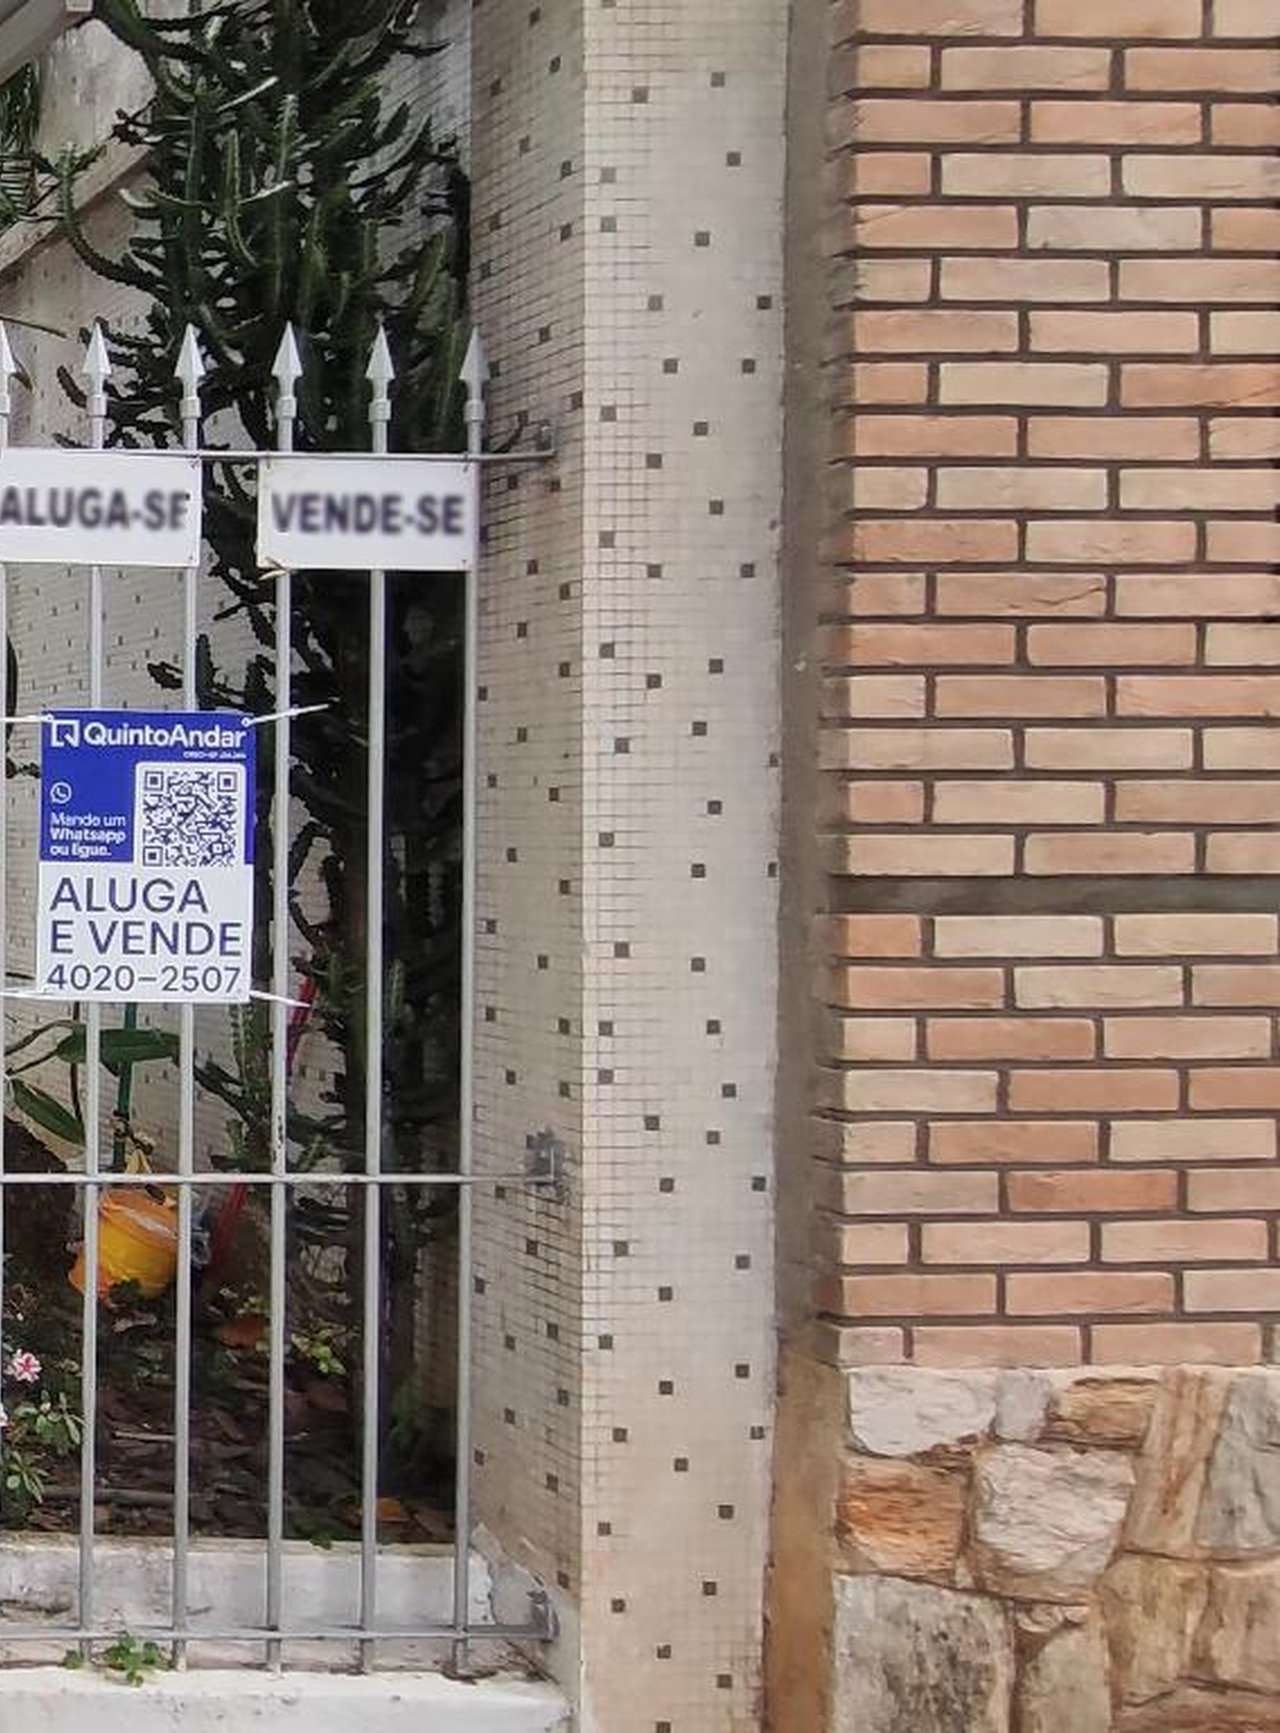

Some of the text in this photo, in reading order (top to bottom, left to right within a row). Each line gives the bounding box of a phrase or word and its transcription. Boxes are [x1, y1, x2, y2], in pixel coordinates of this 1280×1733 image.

[271, 490, 465, 536] VENDE-SE
[84, 722, 247, 748] QuintoAndar
[103, 815, 127, 827] um
[50, 845, 70, 856] ou
[49, 877, 209, 914] ALUGA
[51, 920, 243, 957] E VENDE
[47, 963, 241, 993] 4020-2507
